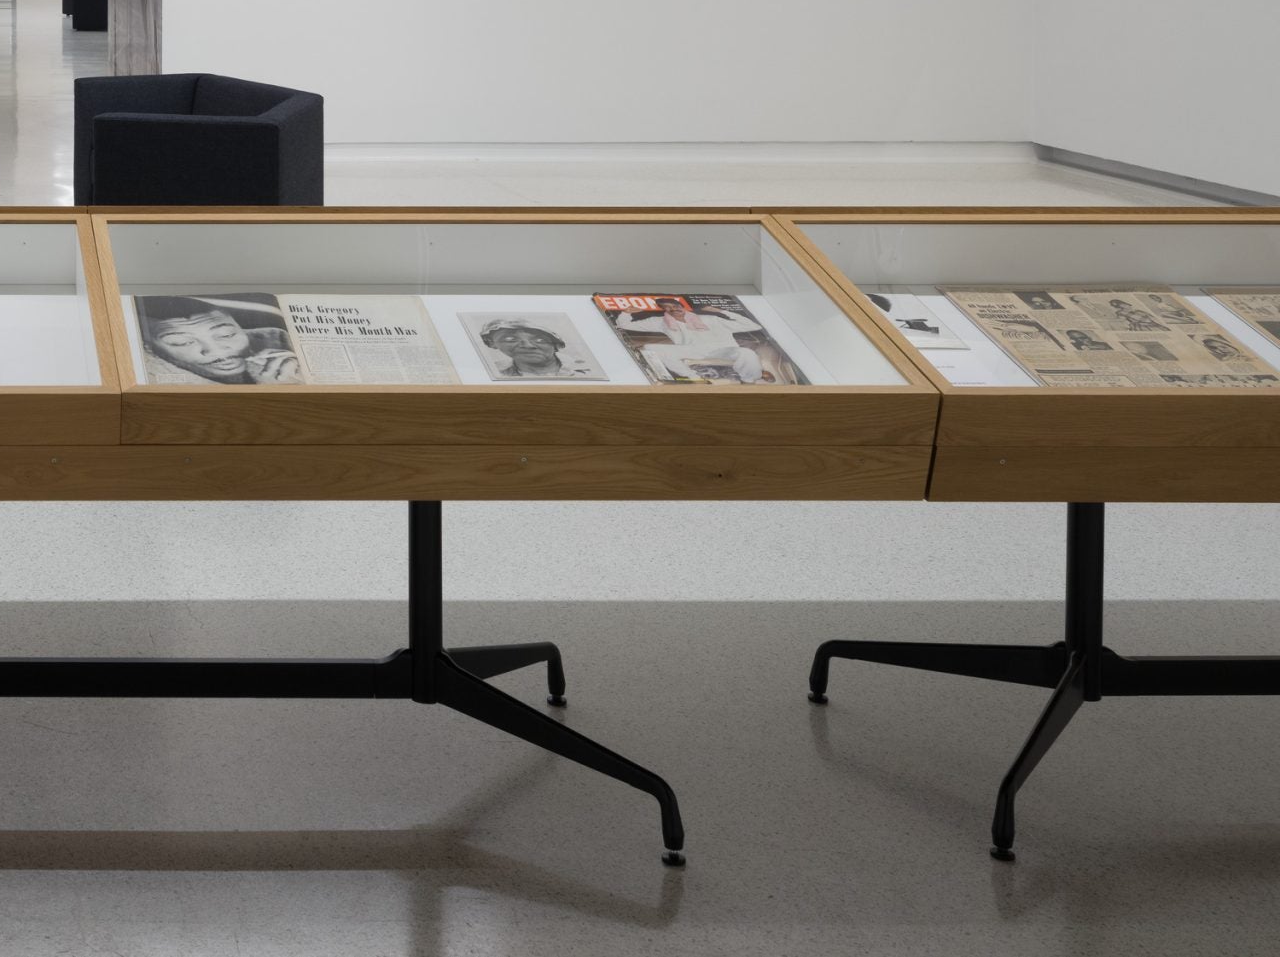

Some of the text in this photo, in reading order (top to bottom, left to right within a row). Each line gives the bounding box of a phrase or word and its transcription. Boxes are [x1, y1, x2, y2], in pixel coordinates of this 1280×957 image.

[288, 304, 360, 315] Dick Gregory
[292, 314, 372, 326] Put His Money
[295, 326, 419, 336] Where His Mouth Was
